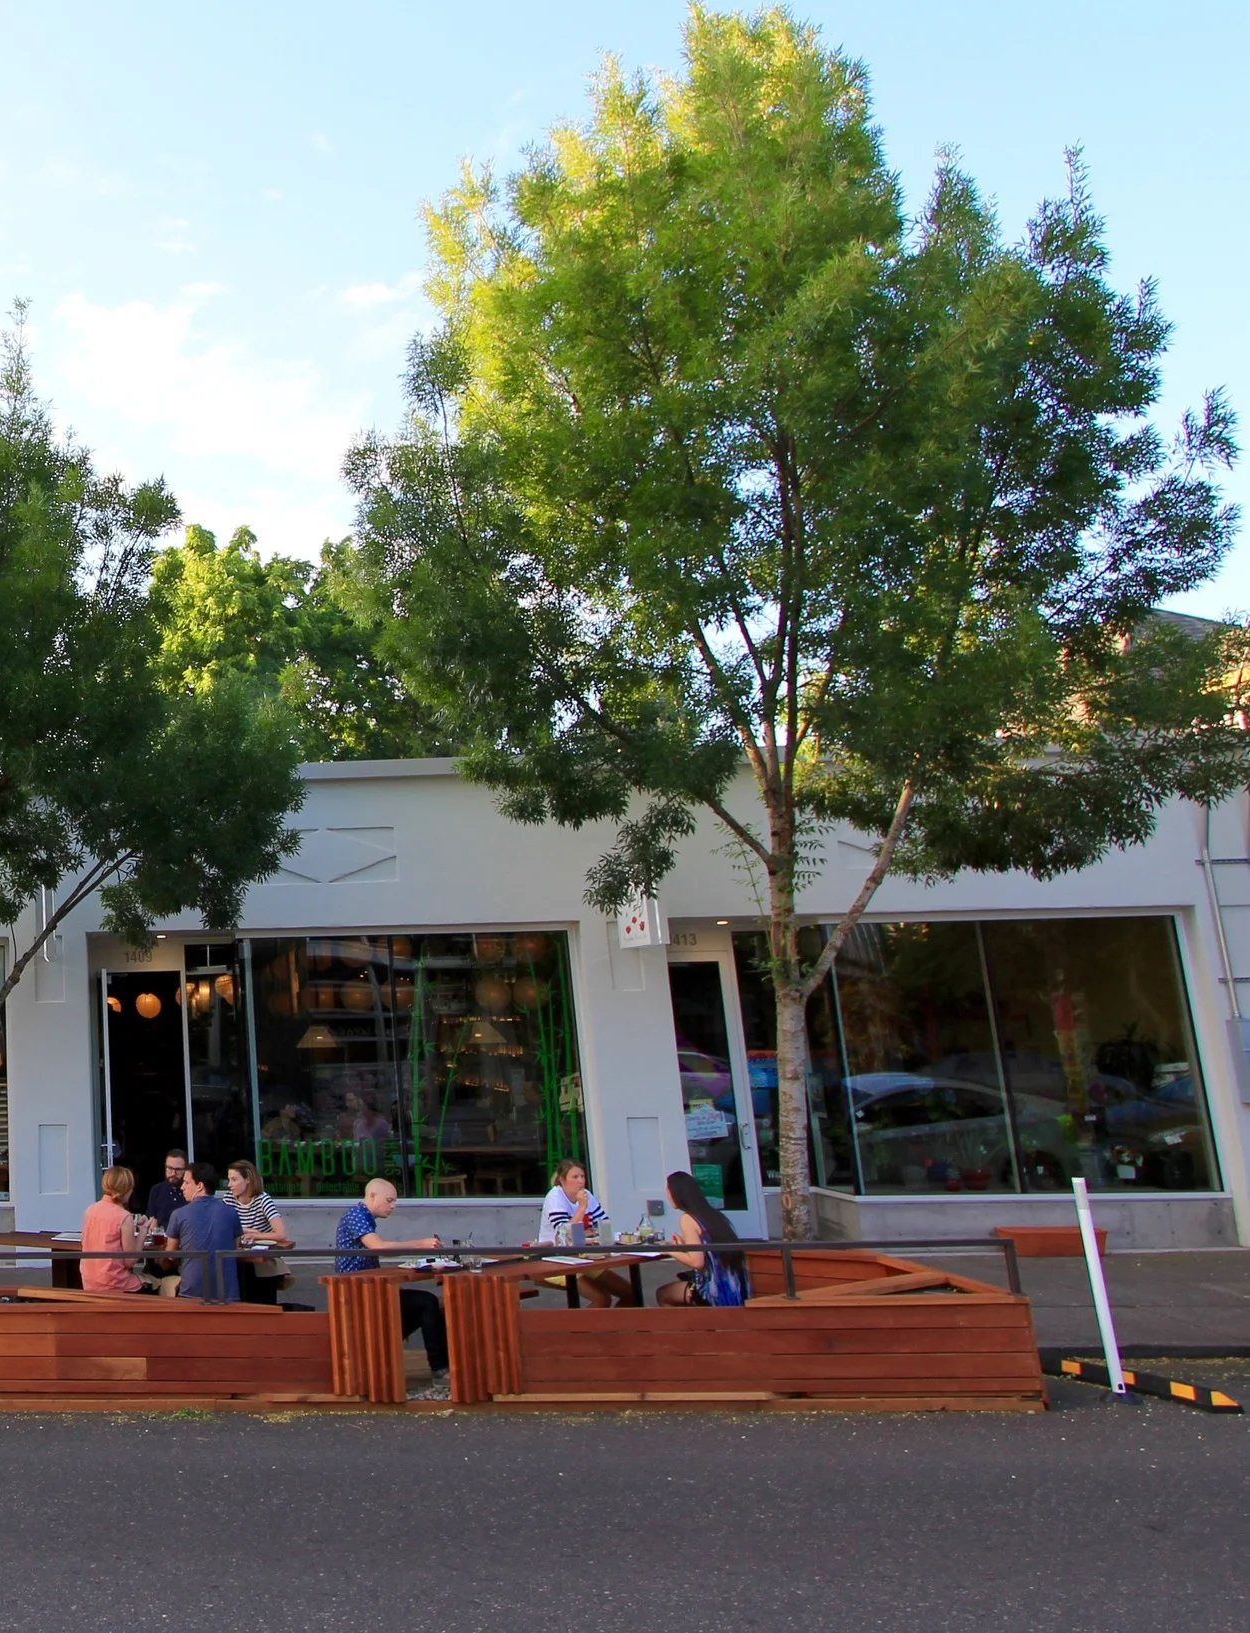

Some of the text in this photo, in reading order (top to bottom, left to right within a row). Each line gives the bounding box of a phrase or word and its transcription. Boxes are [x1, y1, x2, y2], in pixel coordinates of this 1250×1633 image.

[670, 932, 698, 947] 413
[123, 950, 153, 963] 1409
[260, 1138, 378, 1177] BAMBOO
[382, 1137, 402, 1176] SUSHI
